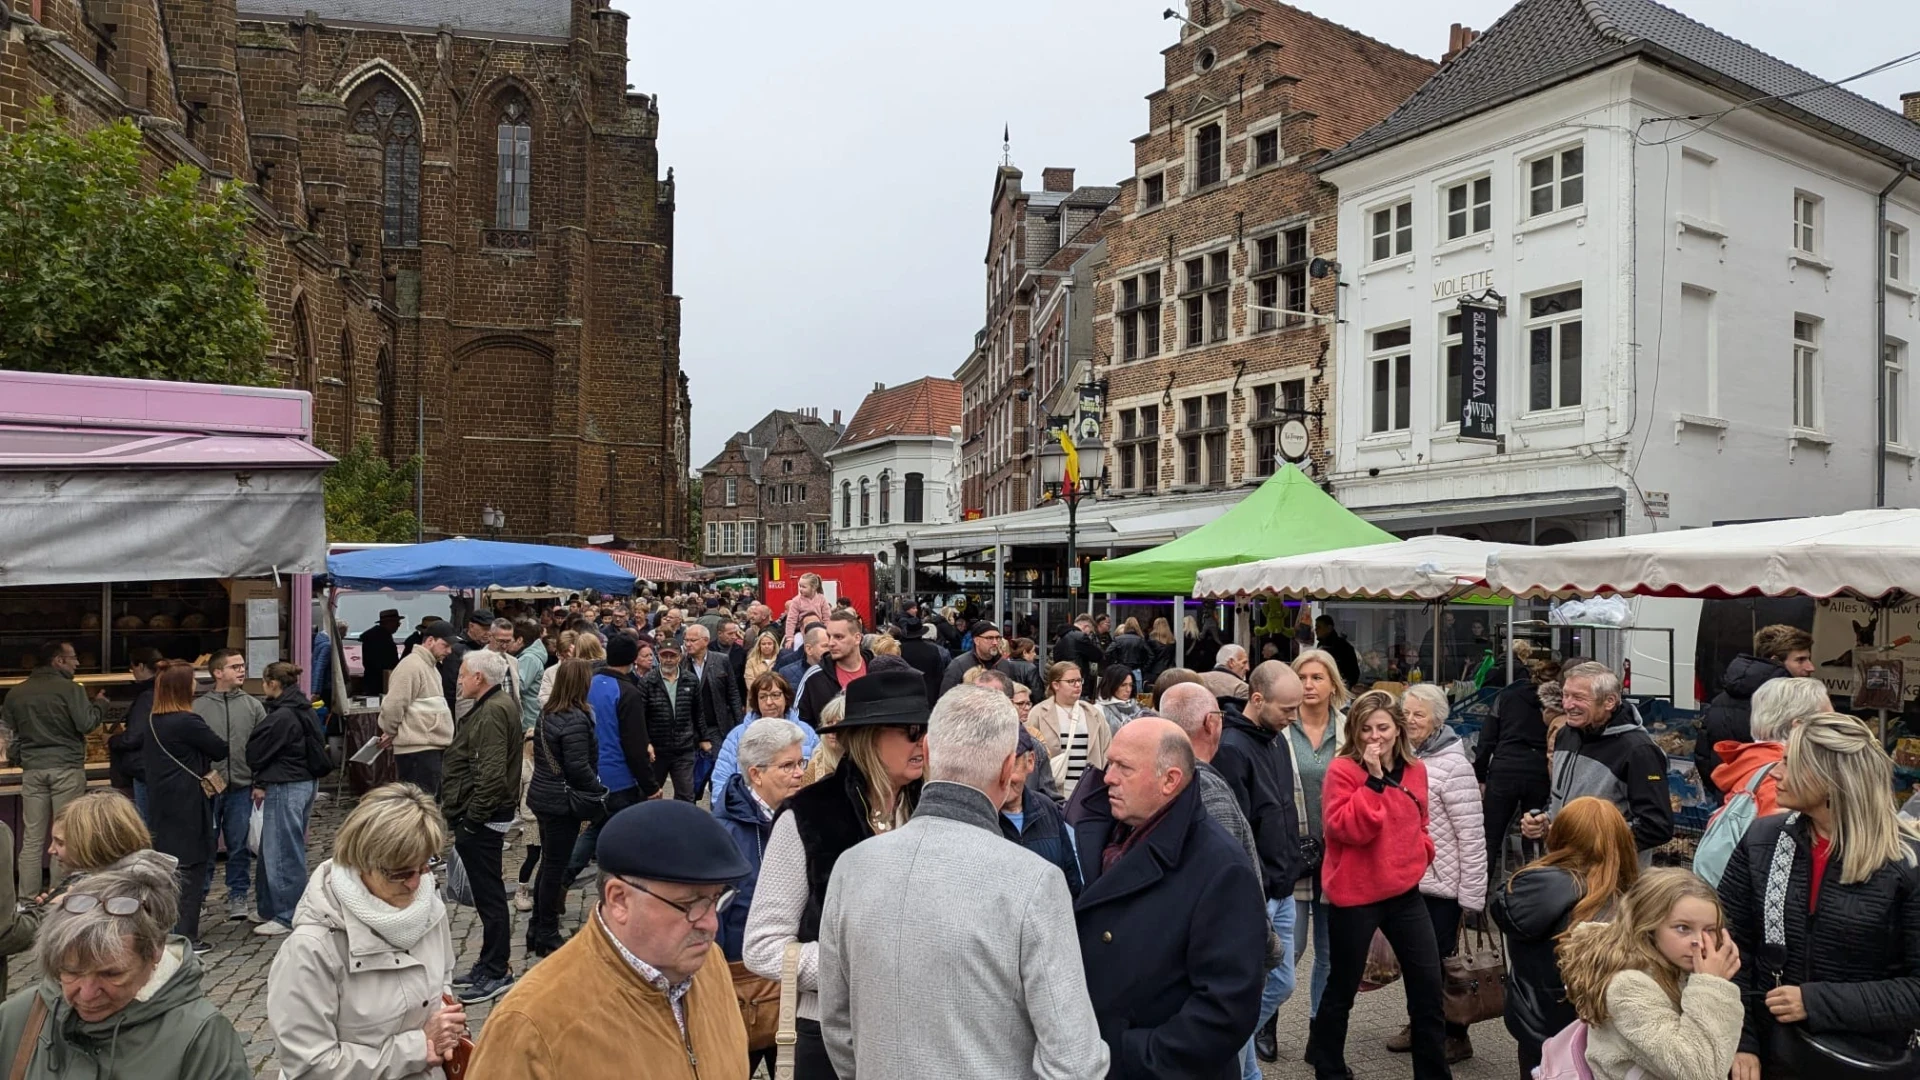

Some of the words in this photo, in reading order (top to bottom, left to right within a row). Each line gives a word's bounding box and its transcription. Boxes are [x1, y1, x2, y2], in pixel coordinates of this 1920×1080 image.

[1434, 269, 1494, 297] VIOLETTE
[1473, 311, 1486, 398] VIOLETTE
[1471, 402, 1495, 421] WIJN
[1481, 422, 1494, 433] BAR
[1829, 602, 1858, 613] Alles
